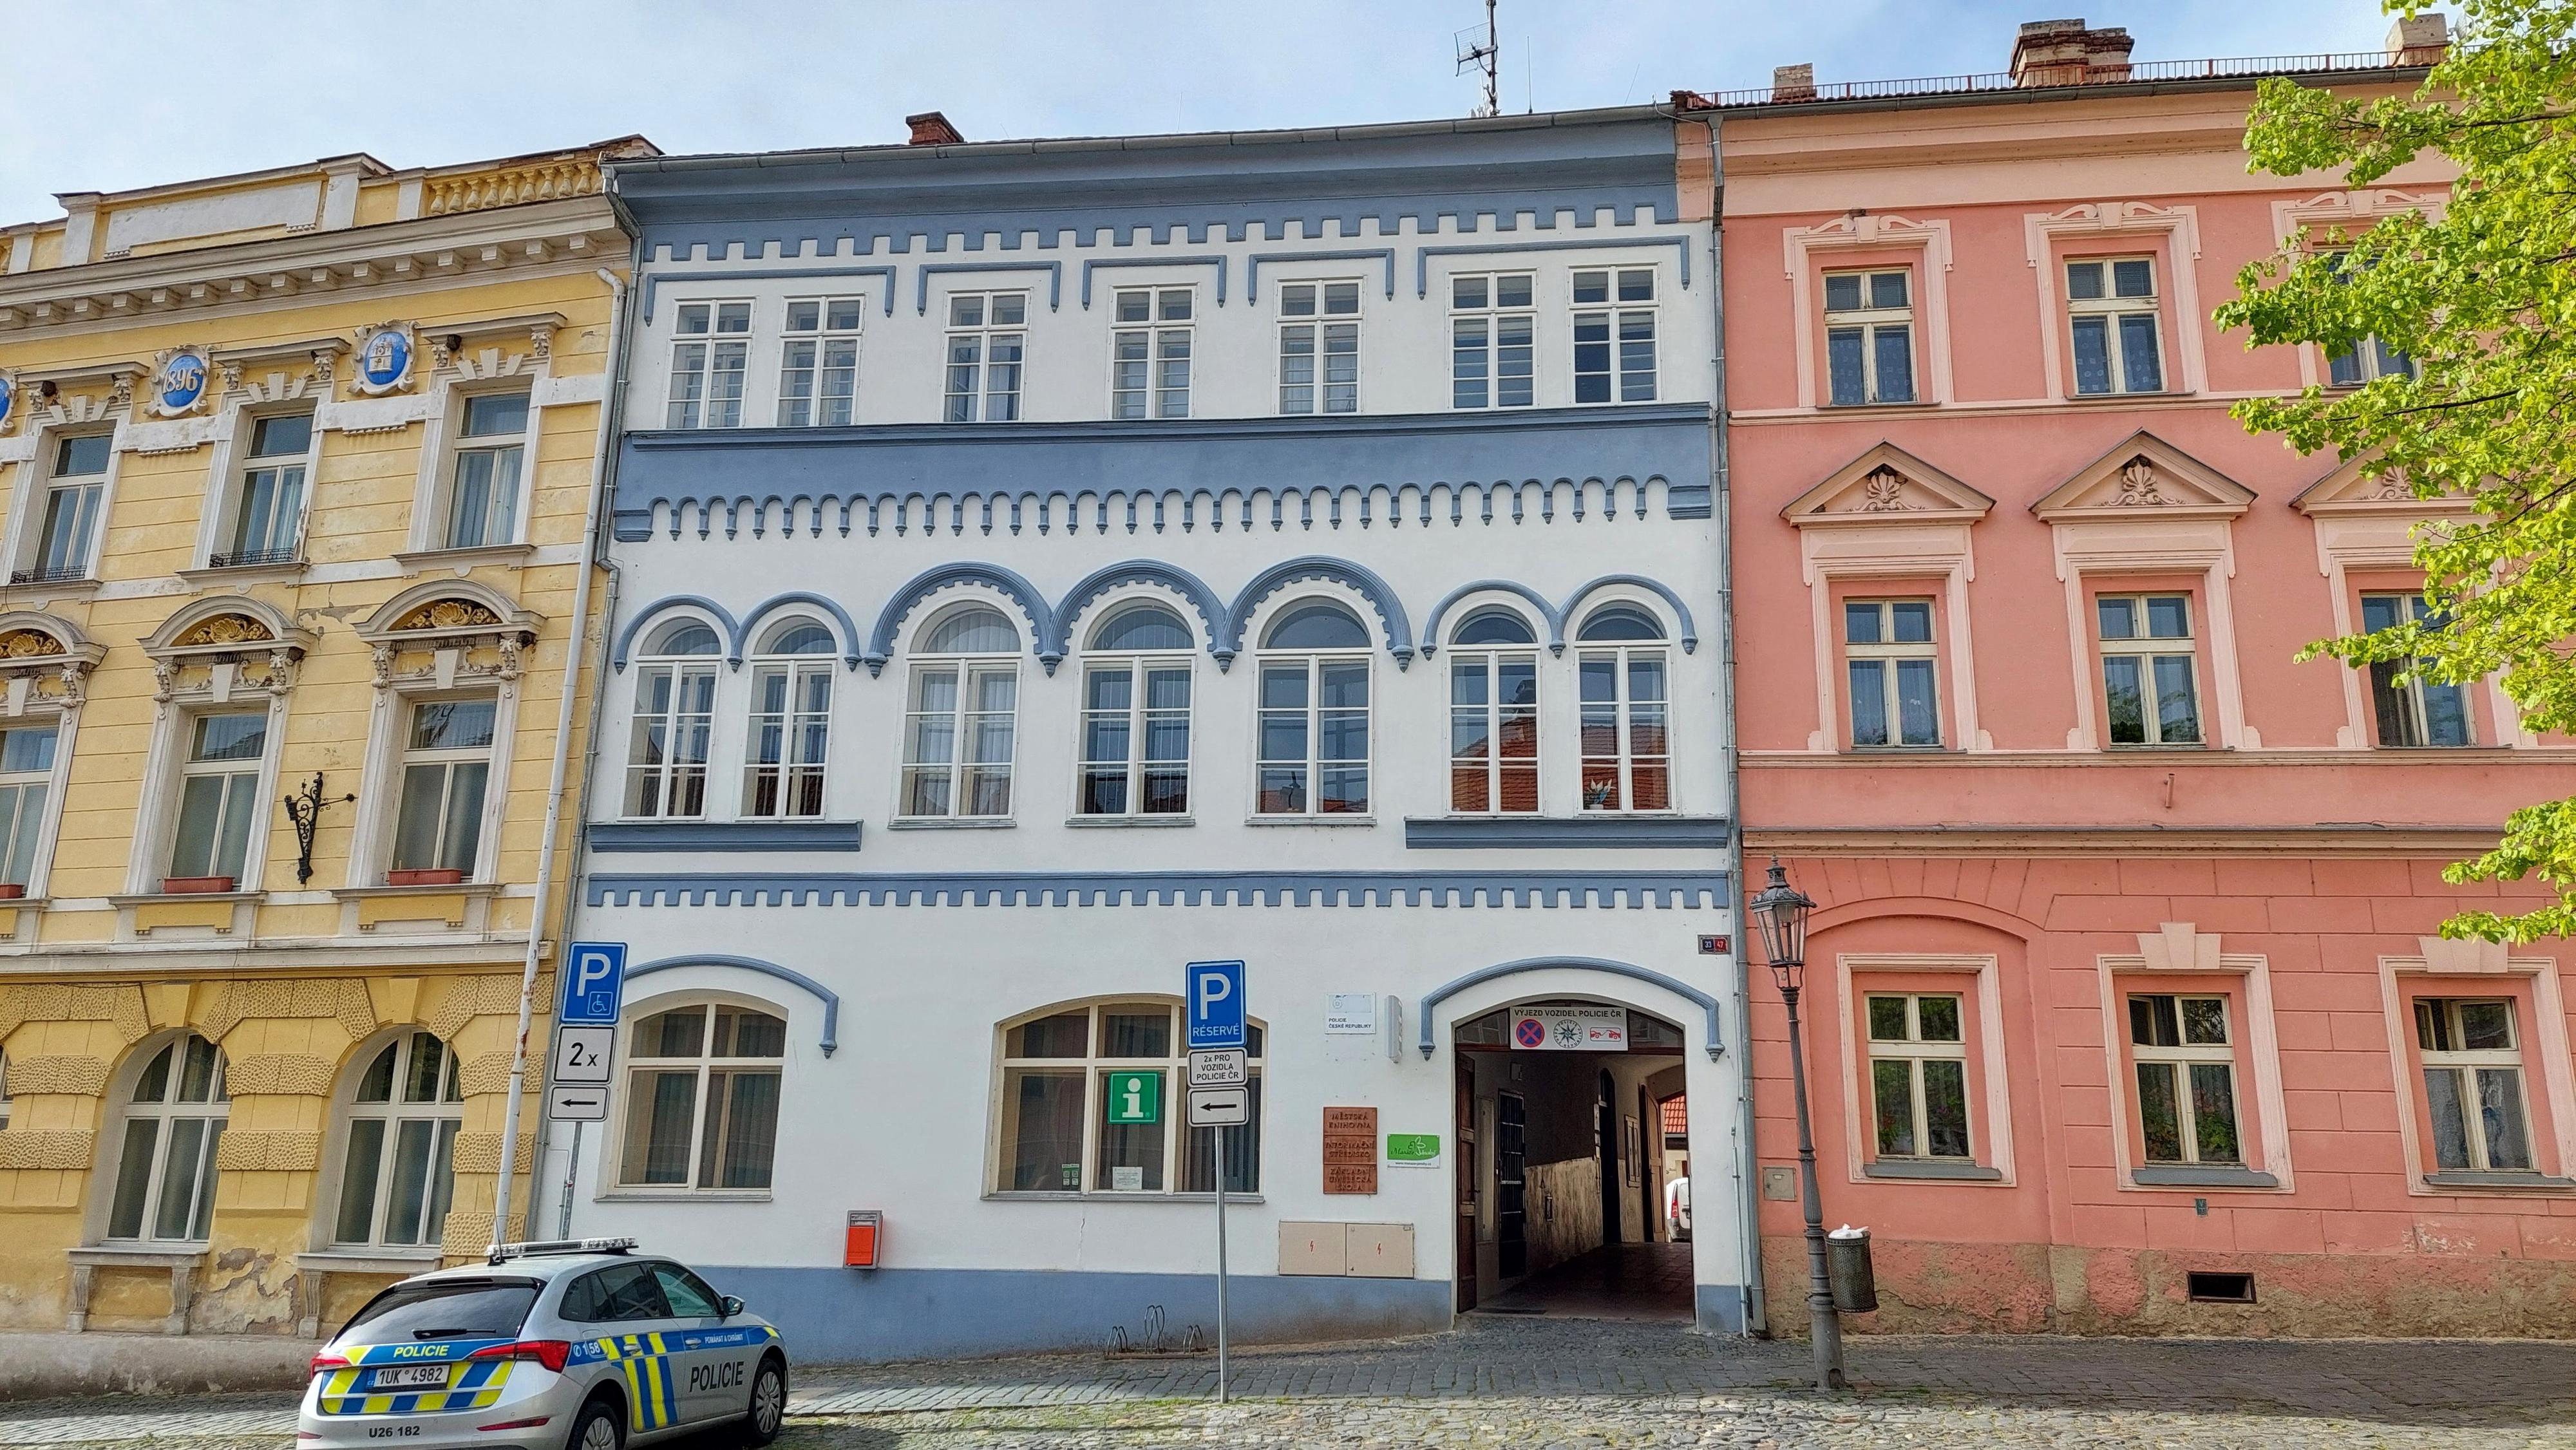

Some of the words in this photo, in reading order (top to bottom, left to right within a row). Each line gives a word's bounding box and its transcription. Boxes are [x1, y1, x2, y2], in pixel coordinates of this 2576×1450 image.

[162, 368, 198, 394] 1896
[576, 953, 611, 997] P
[1199, 973, 1231, 1020] P
[1514, 1008, 1543, 1017] VÝJEZD
[1611, 1008, 1622, 1018] ČR
[1193, 1022, 1240, 1037] RÉSERVÉ
[1214, 1053, 1230, 1062] PRO
[1201, 1063, 1234, 1071] VOZIDLA
[1197, 1072, 1226, 1080] POLICIE
[1228, 1069, 1239, 1080] ČR
[393, 1345, 450, 1358] POLICIE
[379, 1369, 402, 1385] 1UK
[410, 1367, 443, 1383] 4982
[689, 1361, 744, 1393] POLICIE
[369, 1427, 393, 1438] U26
[397, 1426, 421, 1436] 182
